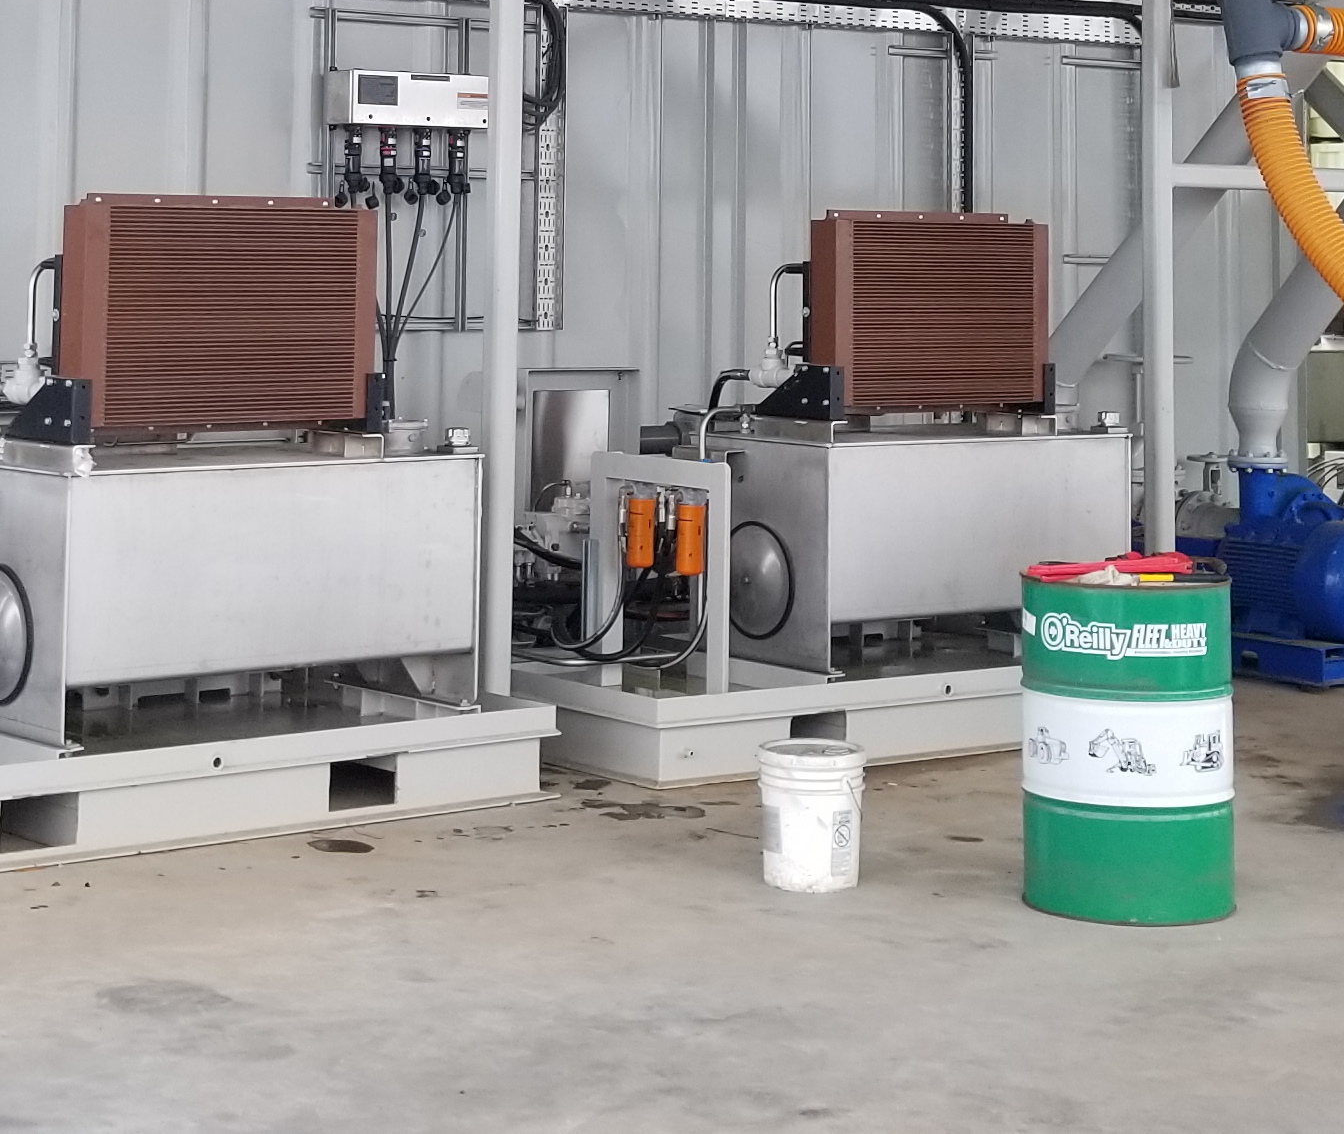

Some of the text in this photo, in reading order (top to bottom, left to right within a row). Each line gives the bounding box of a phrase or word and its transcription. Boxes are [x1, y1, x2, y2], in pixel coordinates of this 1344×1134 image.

[1043, 615, 1127, 656] O'Reilly
[1131, 624, 1169, 648] FLEET
[1171, 623, 1207, 639] HEAVY
